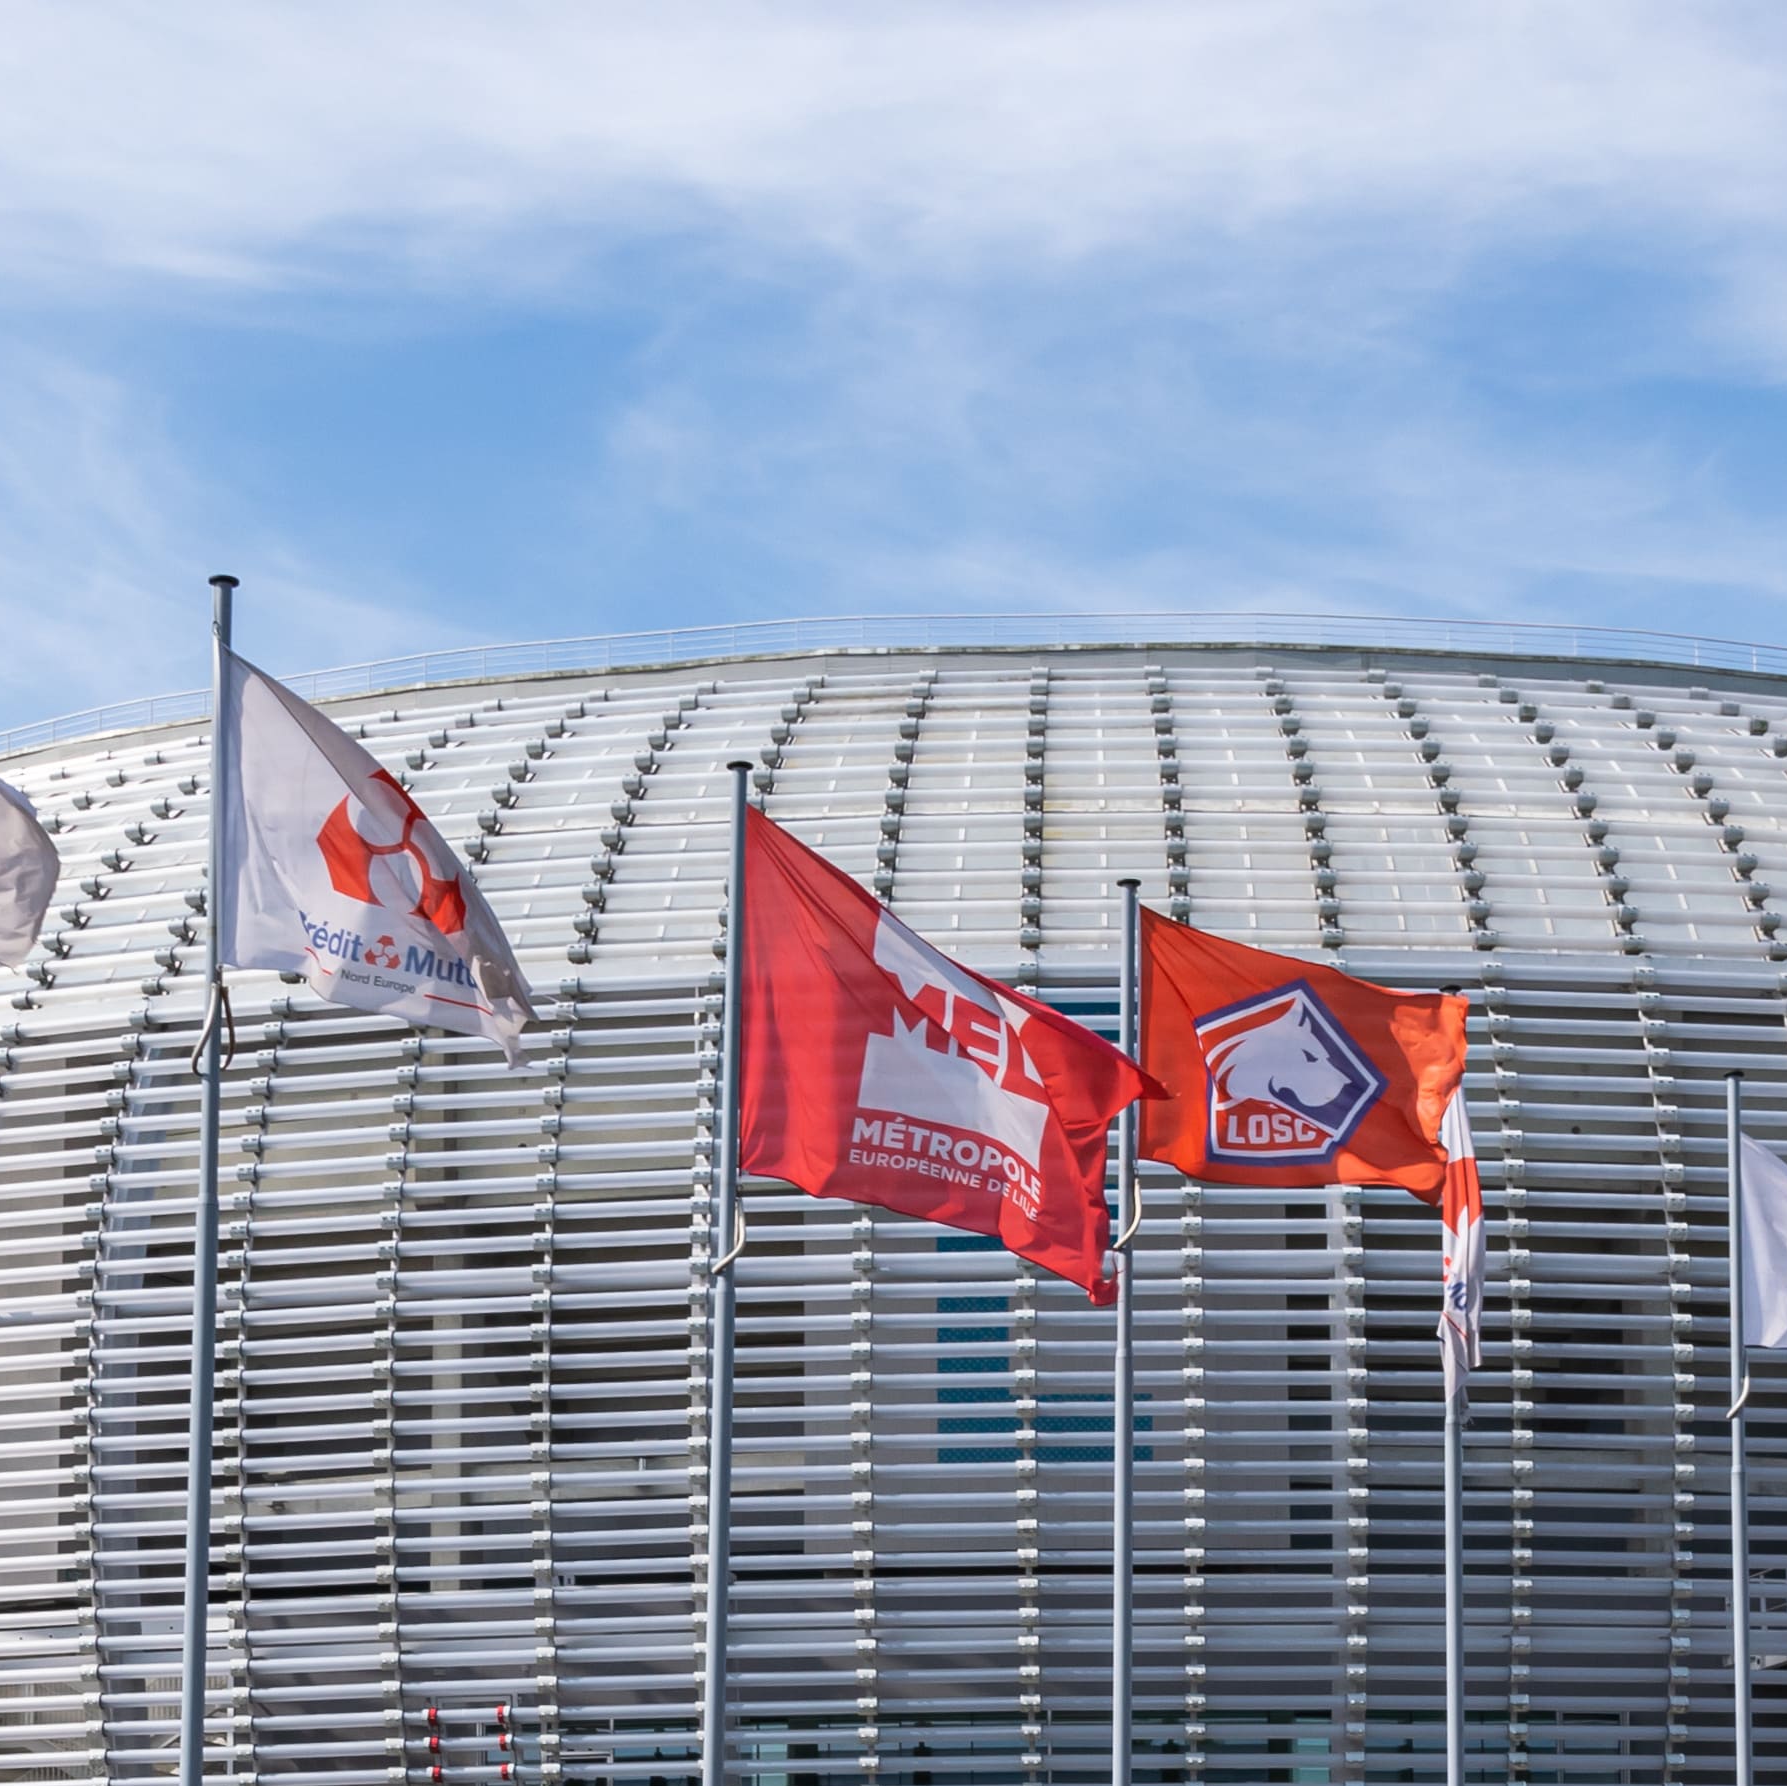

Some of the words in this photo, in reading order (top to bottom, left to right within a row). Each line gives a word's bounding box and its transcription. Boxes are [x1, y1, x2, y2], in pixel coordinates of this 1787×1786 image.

[341, 969, 370, 986] Nord
[1227, 1113, 1318, 1145] LOSC
[848, 1149, 982, 1188] EUROPÉENNE
[987, 1178, 1009, 1197] DE
[851, 1115, 1042, 1204] MÉTROPOLE
